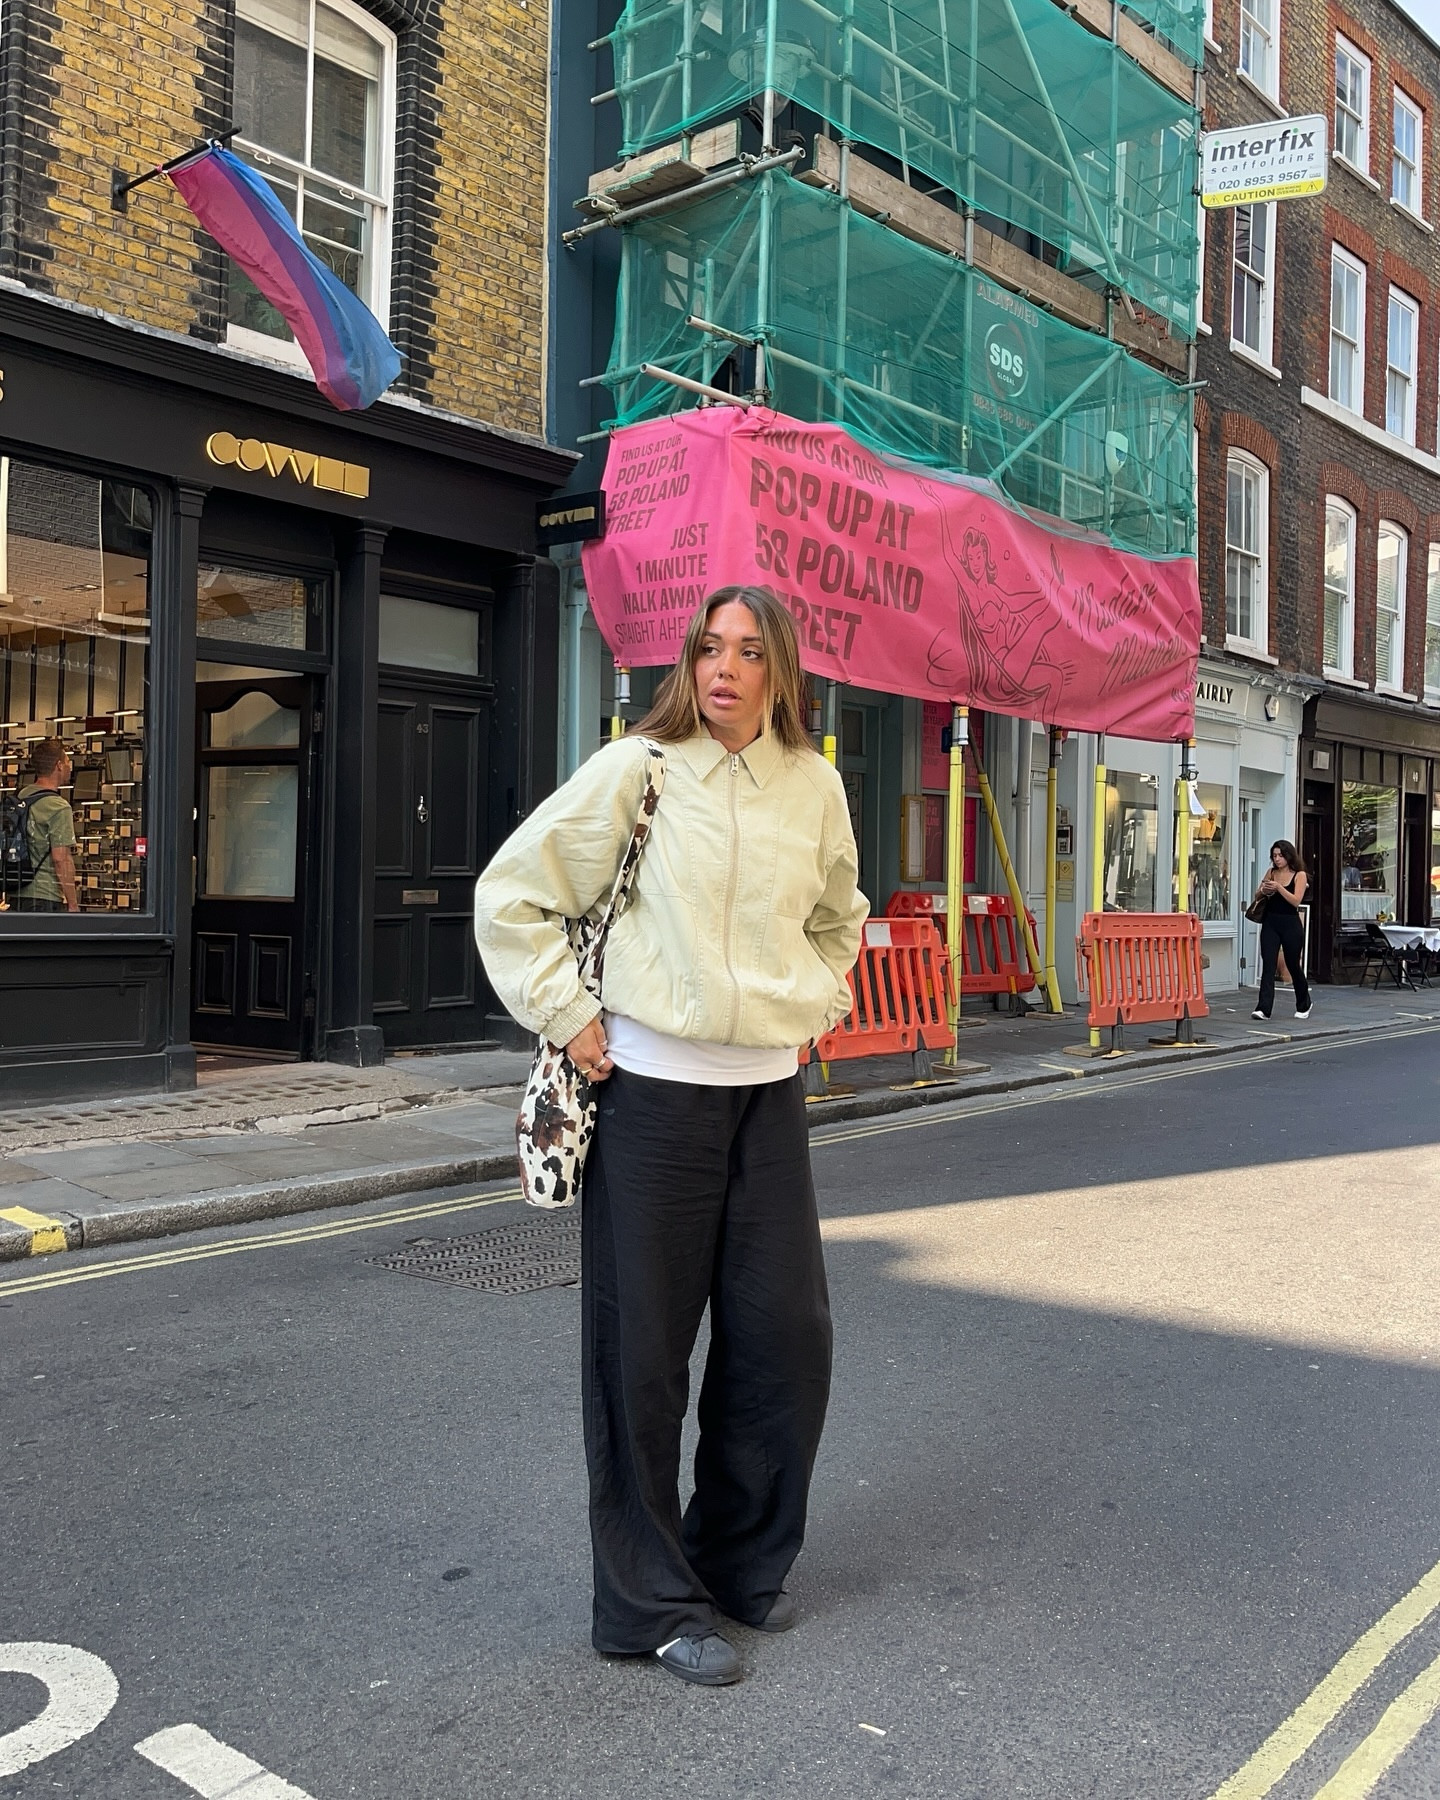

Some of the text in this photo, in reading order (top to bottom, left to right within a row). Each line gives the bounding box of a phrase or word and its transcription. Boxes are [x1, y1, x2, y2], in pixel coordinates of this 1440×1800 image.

[1211, 127, 1315, 162] interfix
[1211, 152, 1315, 175] scaffolding
[1218, 179, 1240, 190] 020
[1244, 174, 1274, 187] 8953
[1278, 169, 1308, 182] 9567
[1223, 188, 1276, 203] CAUTION
[989, 342, 1023, 378] SDS
[997, 371, 1015, 386] GLOBAL
[621, 433, 683, 463] FIND US AT OUR
[801, 432, 826, 465] US
[831, 444, 851, 473] AT
[852, 455, 890, 490] OUR
[615, 447, 688, 489] POP UP AT
[607, 473, 690, 513] 58 POLAND
[749, 456, 915, 551] POP UP AT
[670, 523, 709, 551] JUST
[636, 553, 708, 584] 1 MINUTE
[755, 521, 924, 614] 58 POLAND
[622, 583, 708, 616] WALK AWAY
[1194, 681, 1233, 704] AIRLY
[415, 723, 430, 734] 43
